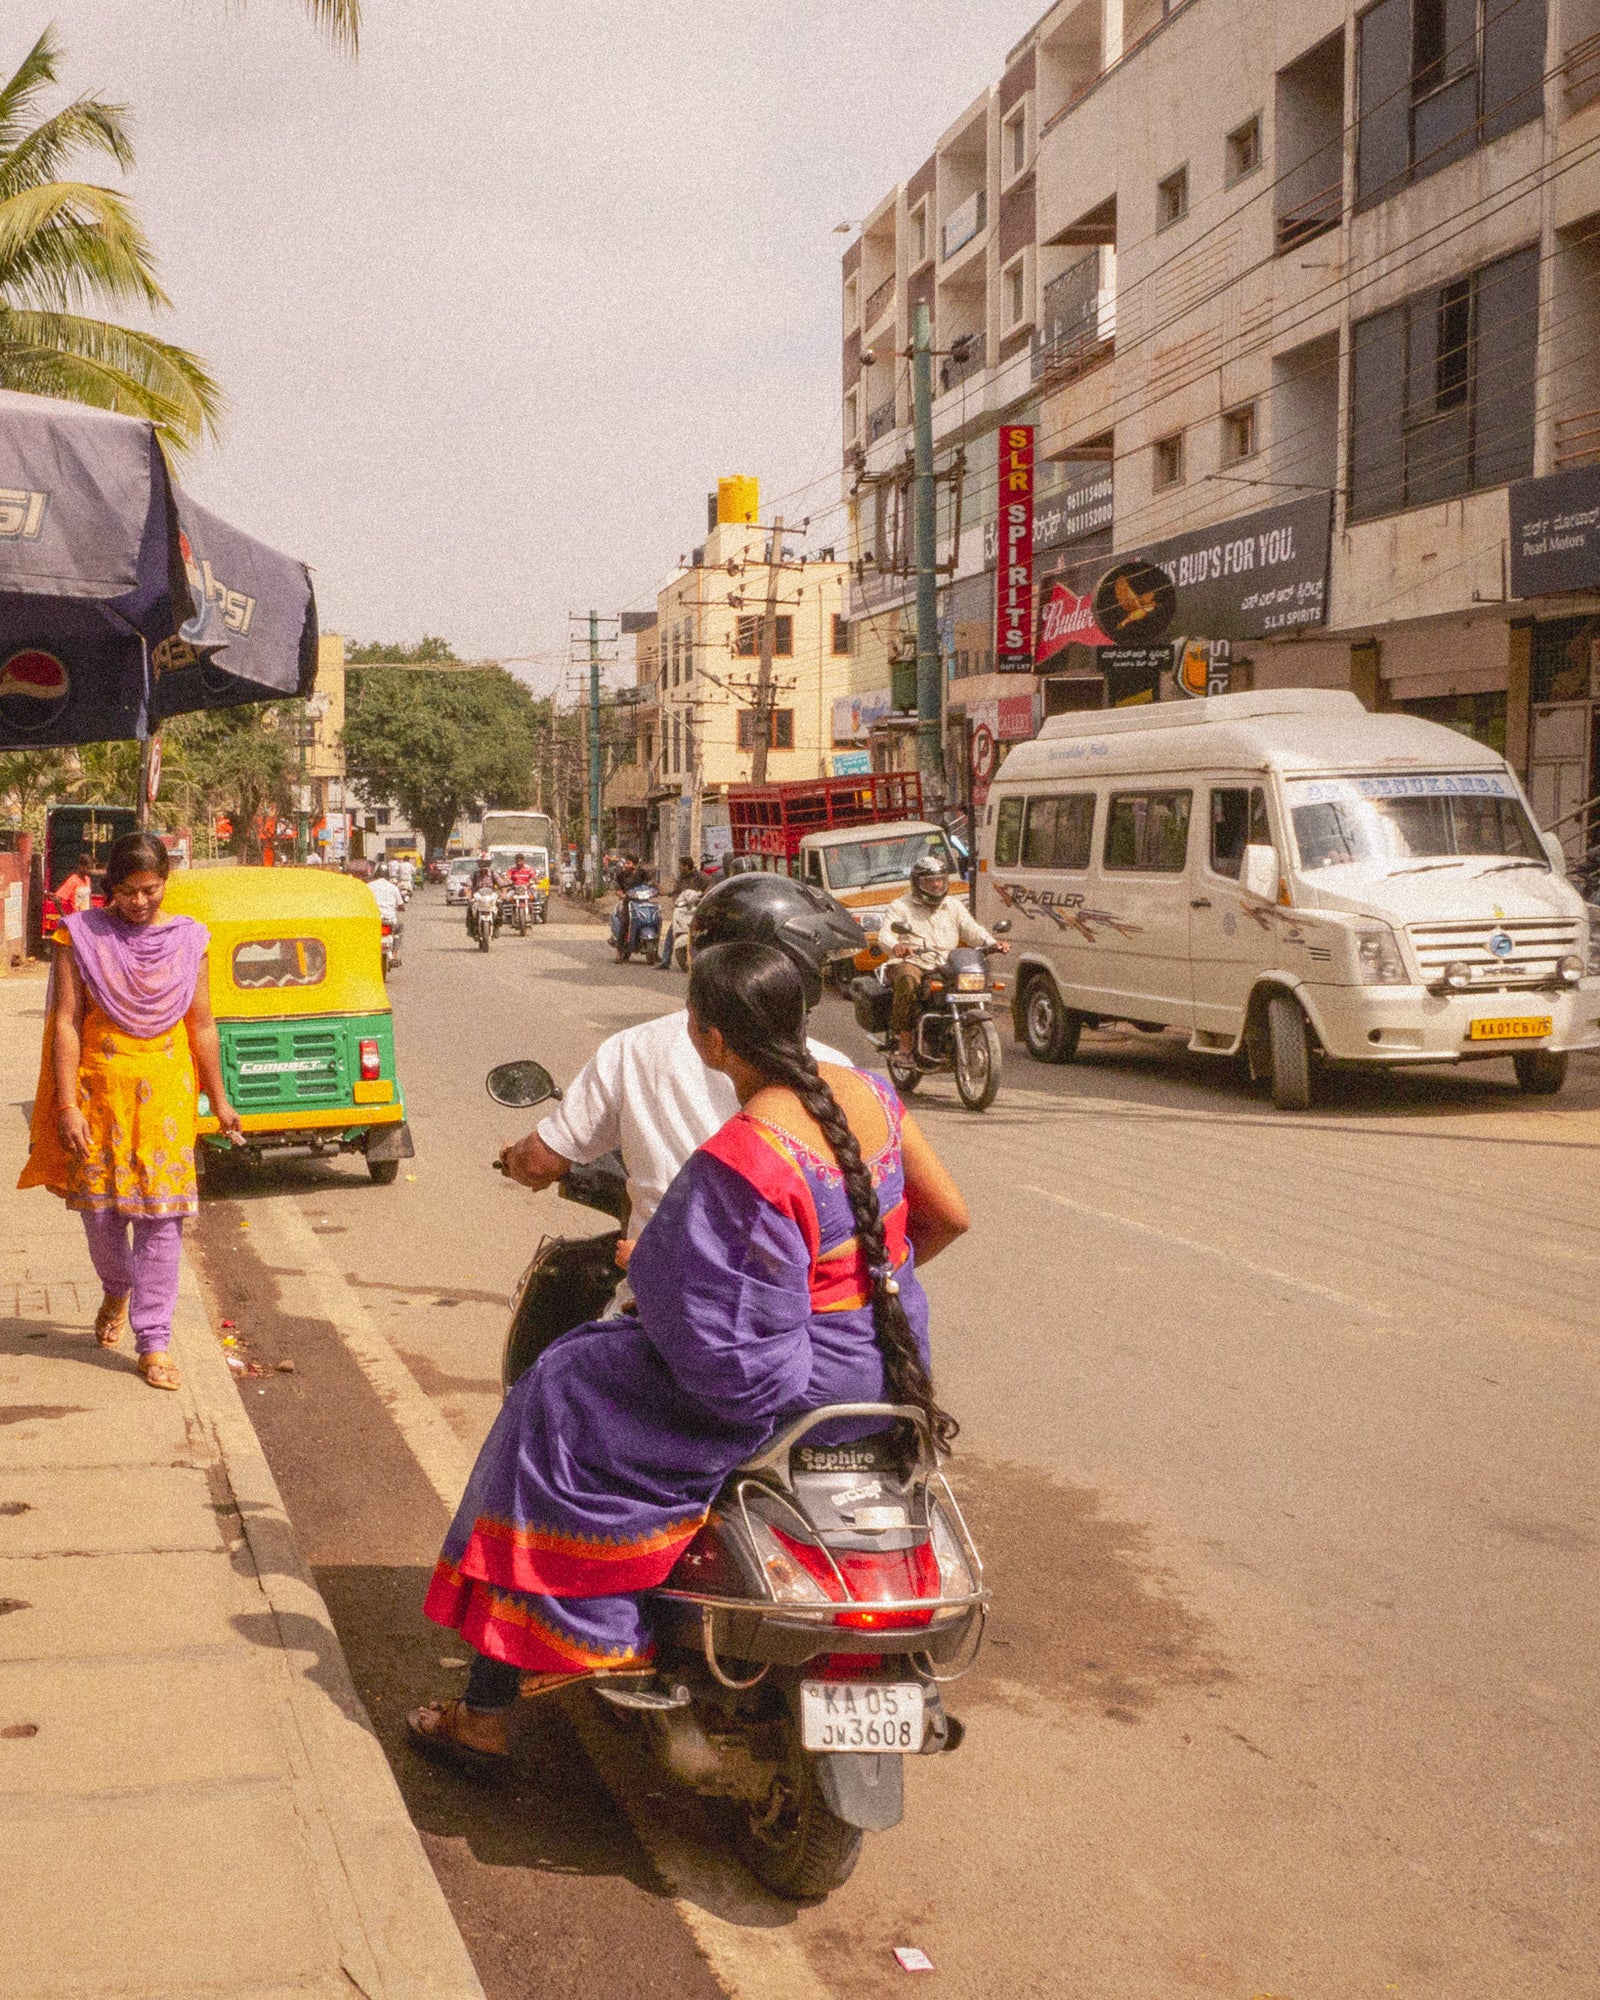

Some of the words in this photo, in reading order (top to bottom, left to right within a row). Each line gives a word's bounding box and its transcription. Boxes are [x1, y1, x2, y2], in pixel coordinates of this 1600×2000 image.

[1008, 430, 1028, 491] SLR
[1178, 545, 1222, 588] BUD'S
[1223, 536, 1255, 576] FOR
[1259, 526, 1297, 567] YOU.
[1006, 505, 1028, 649] SPIRITS
[1286, 606, 1322, 626] SPIRITS
[1003, 883, 1085, 909] TRAVELLER
[800, 1446, 876, 1465] Saphire
[823, 1686, 857, 1714] KA
[865, 1686, 899, 1716] 05
